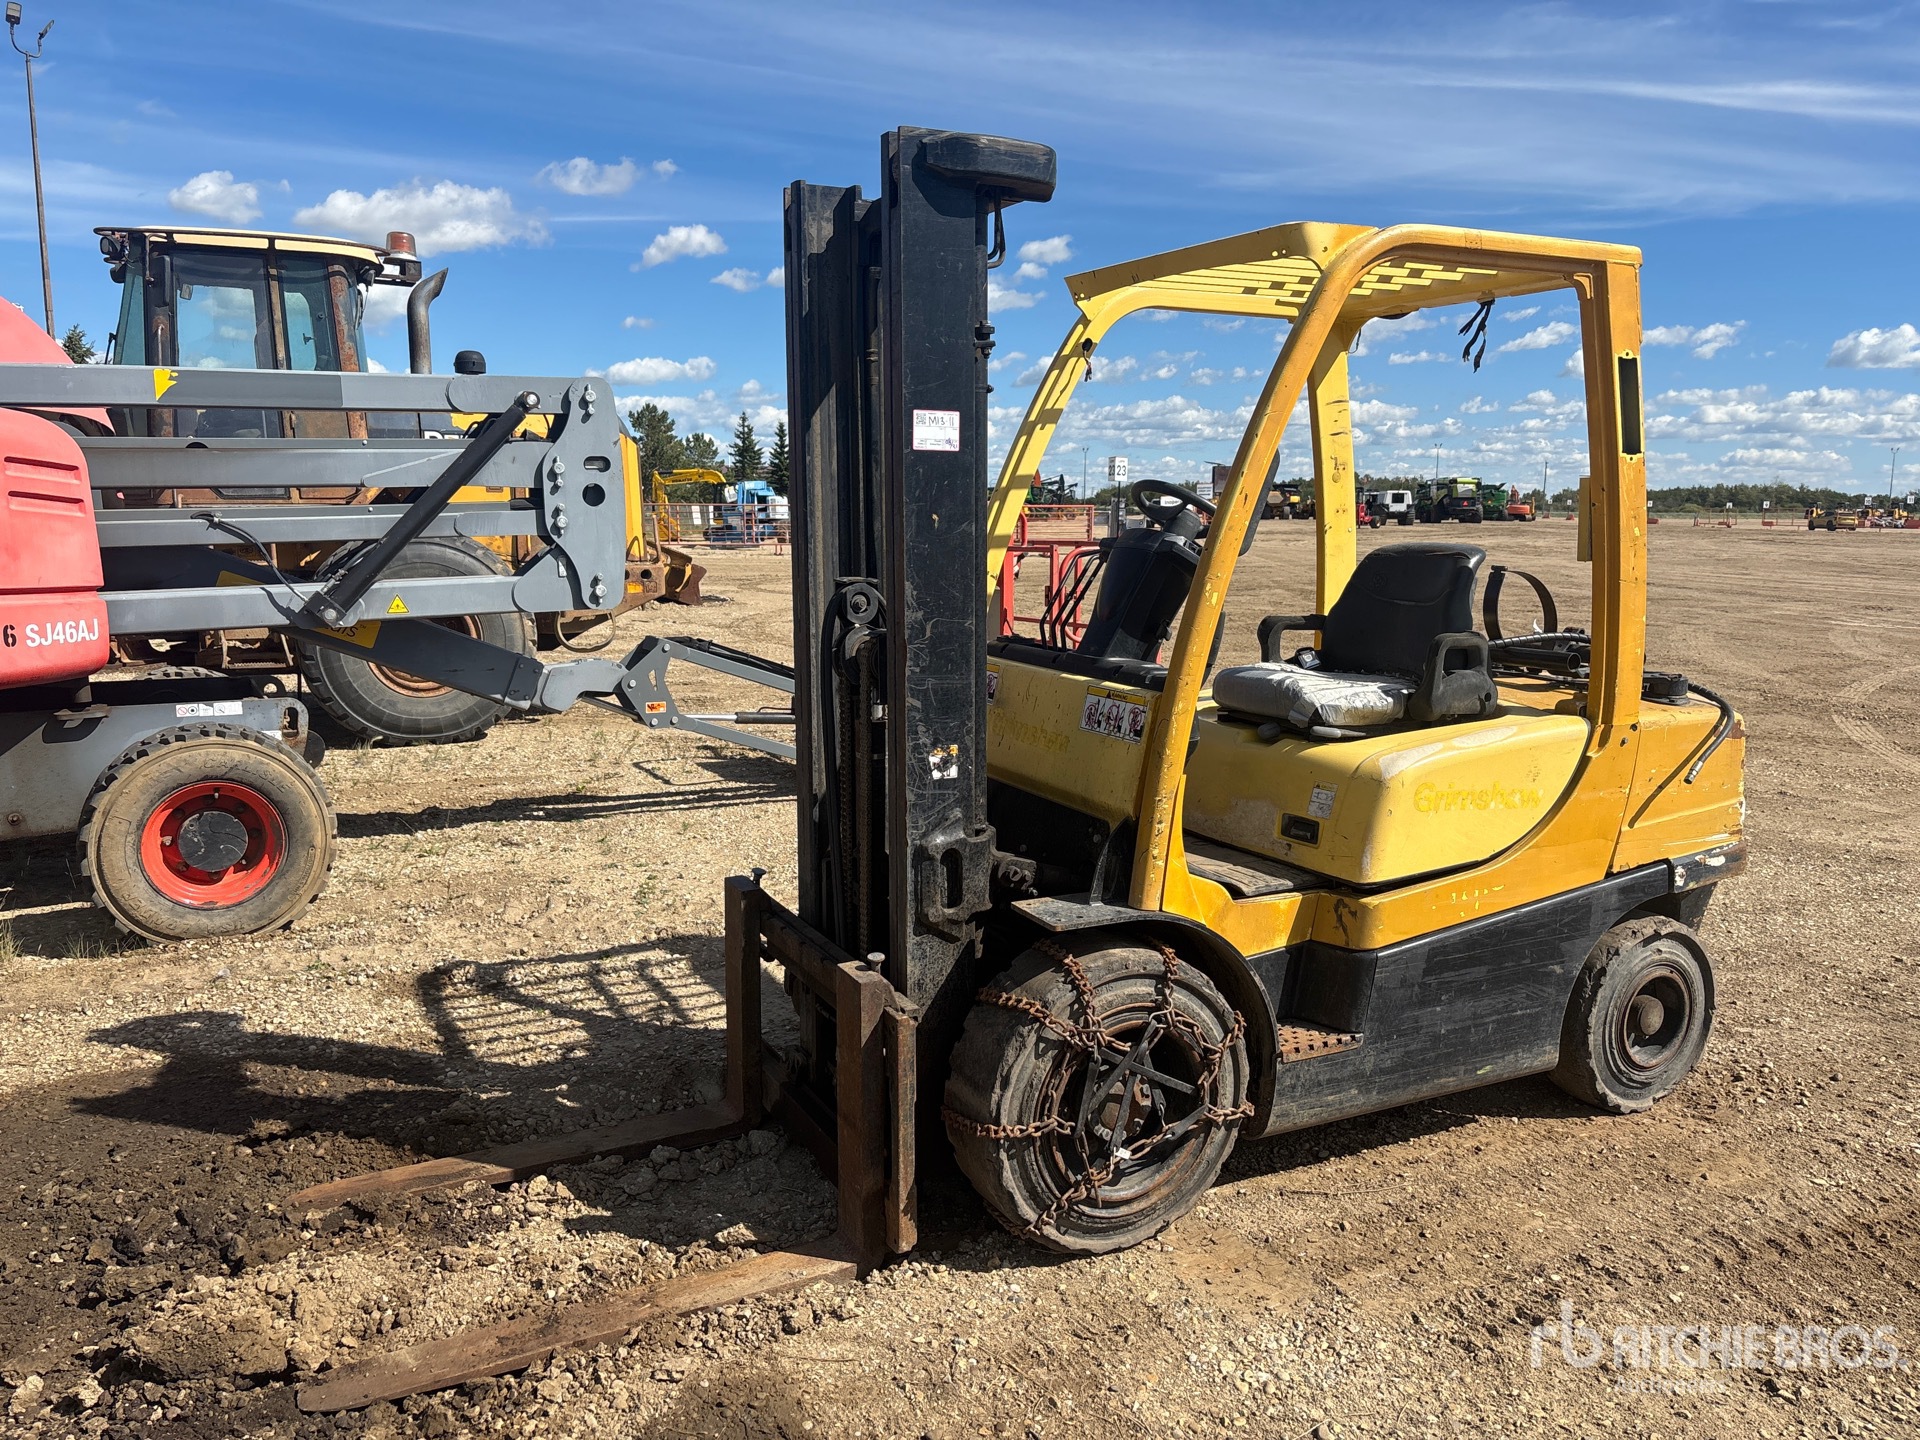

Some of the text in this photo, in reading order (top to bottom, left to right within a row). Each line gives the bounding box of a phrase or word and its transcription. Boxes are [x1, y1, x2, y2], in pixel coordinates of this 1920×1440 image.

[1116, 465, 1127, 476] 23
[25, 618, 99, 648] SJ46AJ
[1414, 781, 1542, 812] Grimshaw
